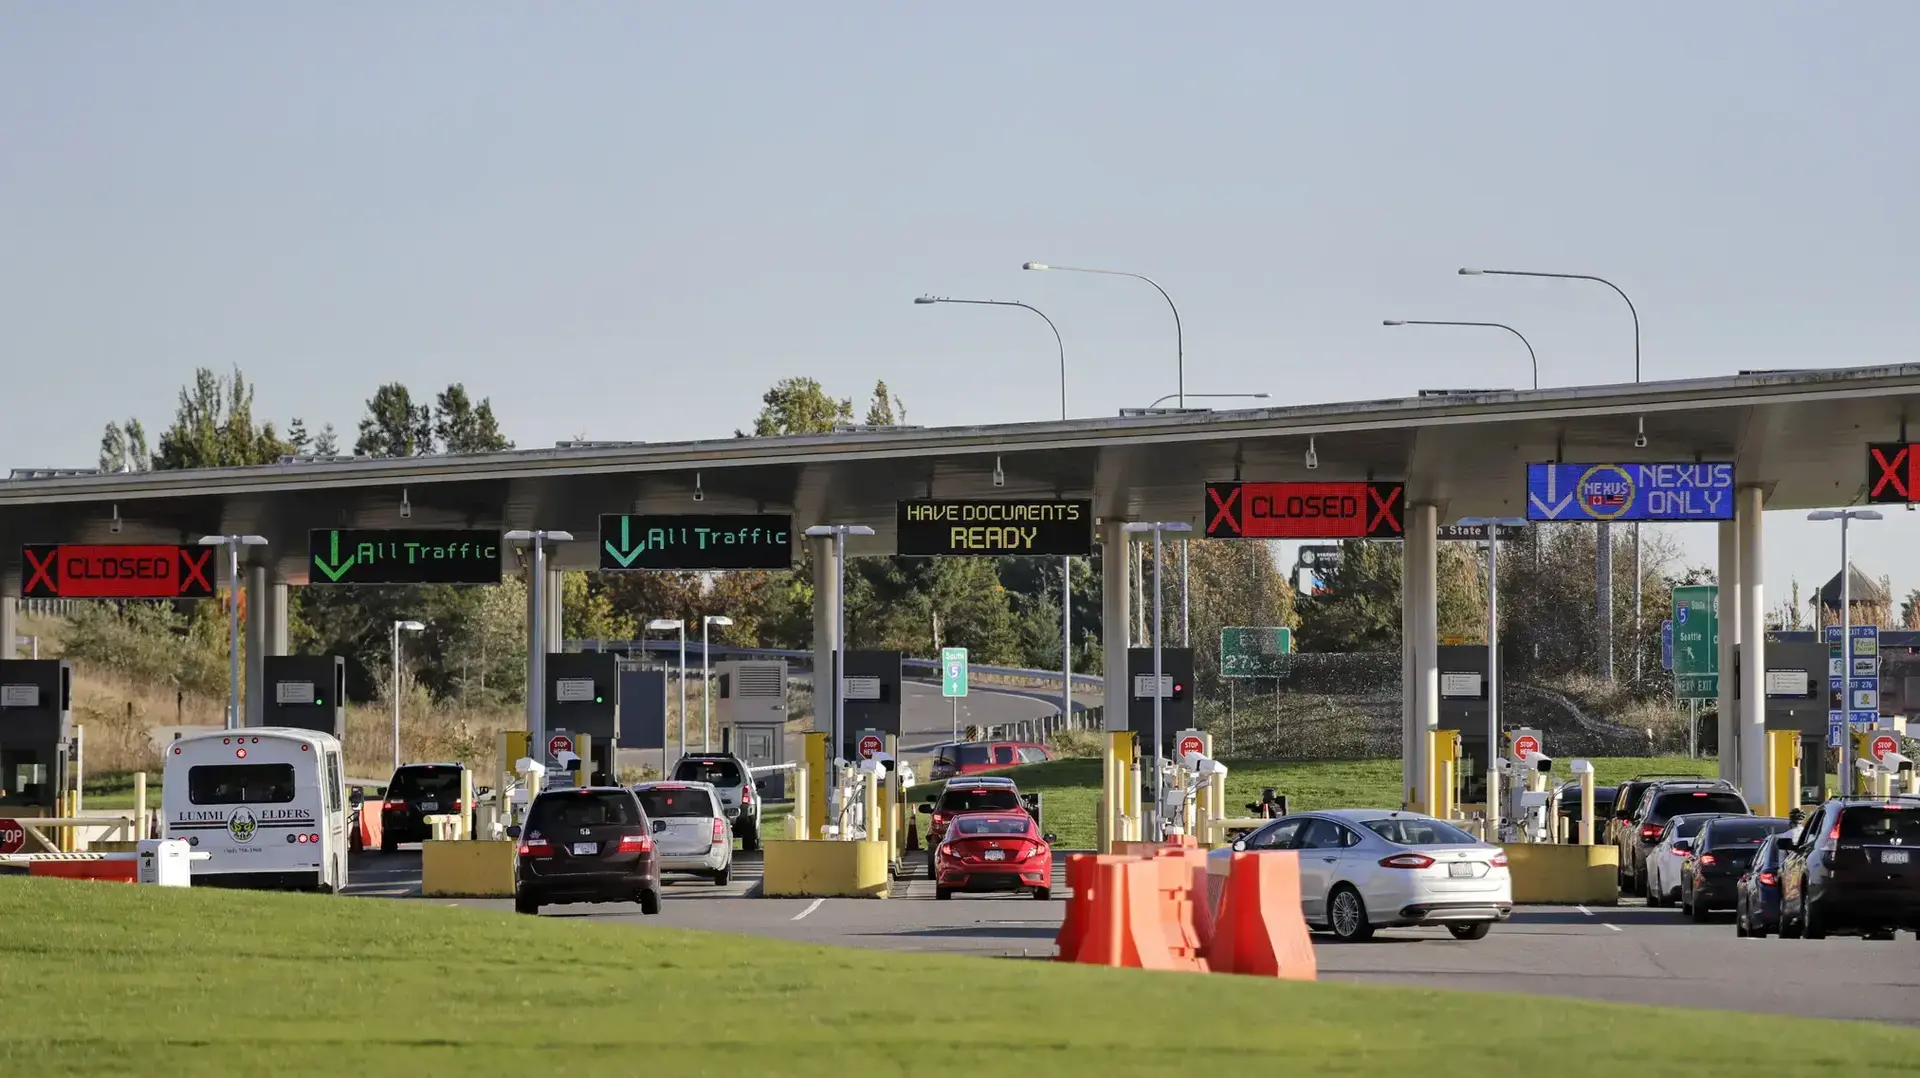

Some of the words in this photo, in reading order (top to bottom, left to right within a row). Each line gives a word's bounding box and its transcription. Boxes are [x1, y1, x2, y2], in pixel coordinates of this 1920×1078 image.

[1639, 464, 1731, 488] NEXUS
[1584, 482, 1629, 495] NEXUS
[1251, 496, 1357, 518] CLOSED
[1648, 490, 1722, 514] ONLY
[907, 505, 958, 520] HAVE
[963, 504, 1079, 520] DOCUMENTS
[951, 526, 1037, 548] READY
[1449, 525, 1481, 535] State
[648, 528, 687, 550] All
[694, 527, 787, 550] Traffic
[357, 542, 396, 564] All
[404, 542, 496, 564] Traffic
[67, 557, 170, 579] CLOSED
[1680, 608, 1686, 623] 5
[1680, 632, 1702, 641] Seattle
[1863, 628, 1875, 636] 276
[951, 666, 958, 678] 5
[1698, 680, 1712, 691] EXIT
[179, 810, 223, 821] LUMMI
[261, 809, 310, 819] ELDERS
